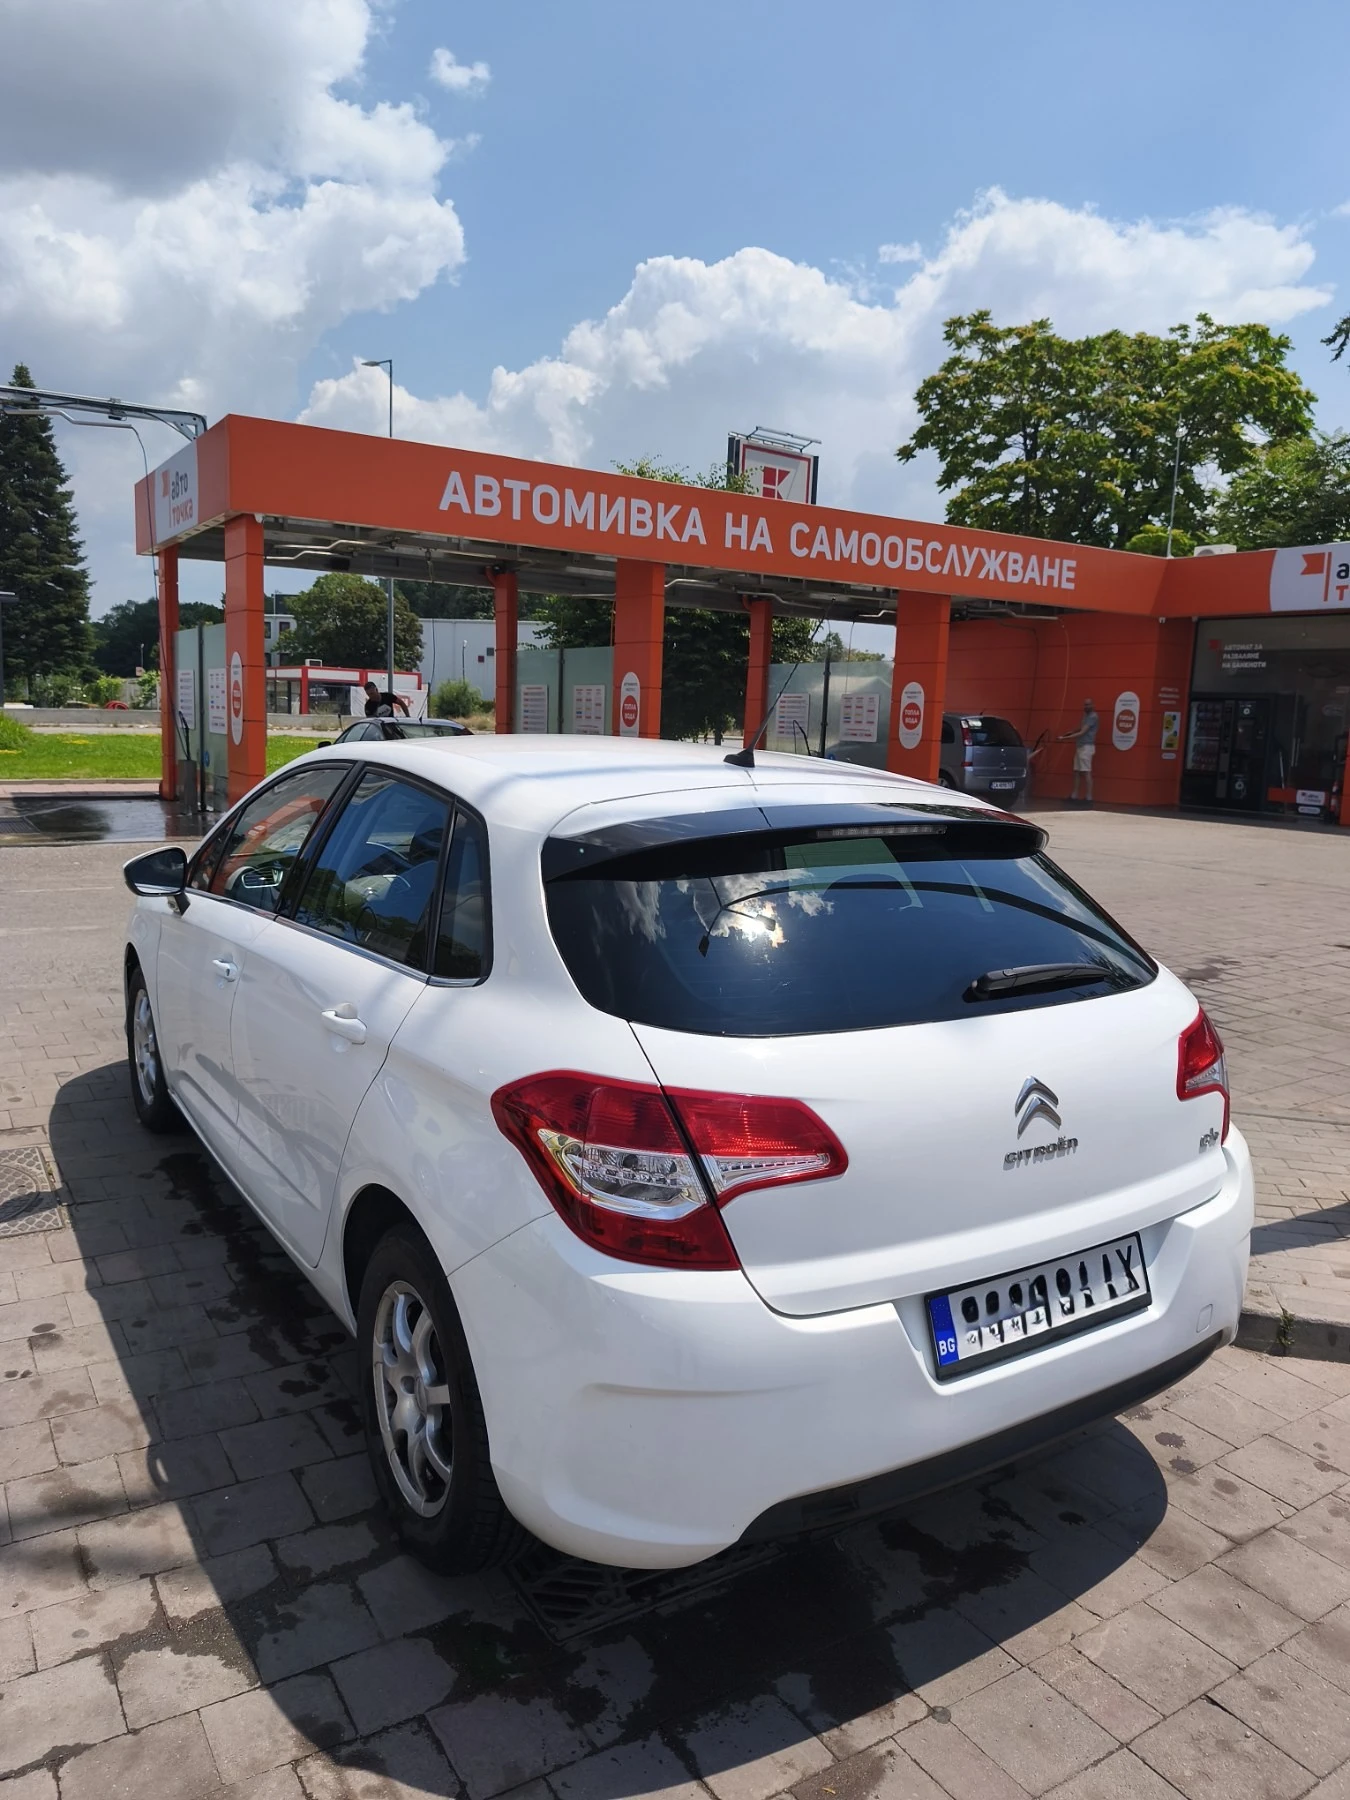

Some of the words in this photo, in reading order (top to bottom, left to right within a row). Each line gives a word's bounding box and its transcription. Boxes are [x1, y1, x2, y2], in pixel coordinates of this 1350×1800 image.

[439, 471, 707, 546] АВТОМИВКА
[725, 512, 773, 553] НА
[790, 522, 1077, 590] САМООБСЛУЖВАНЕ
[939, 1337, 956, 1356] BG
